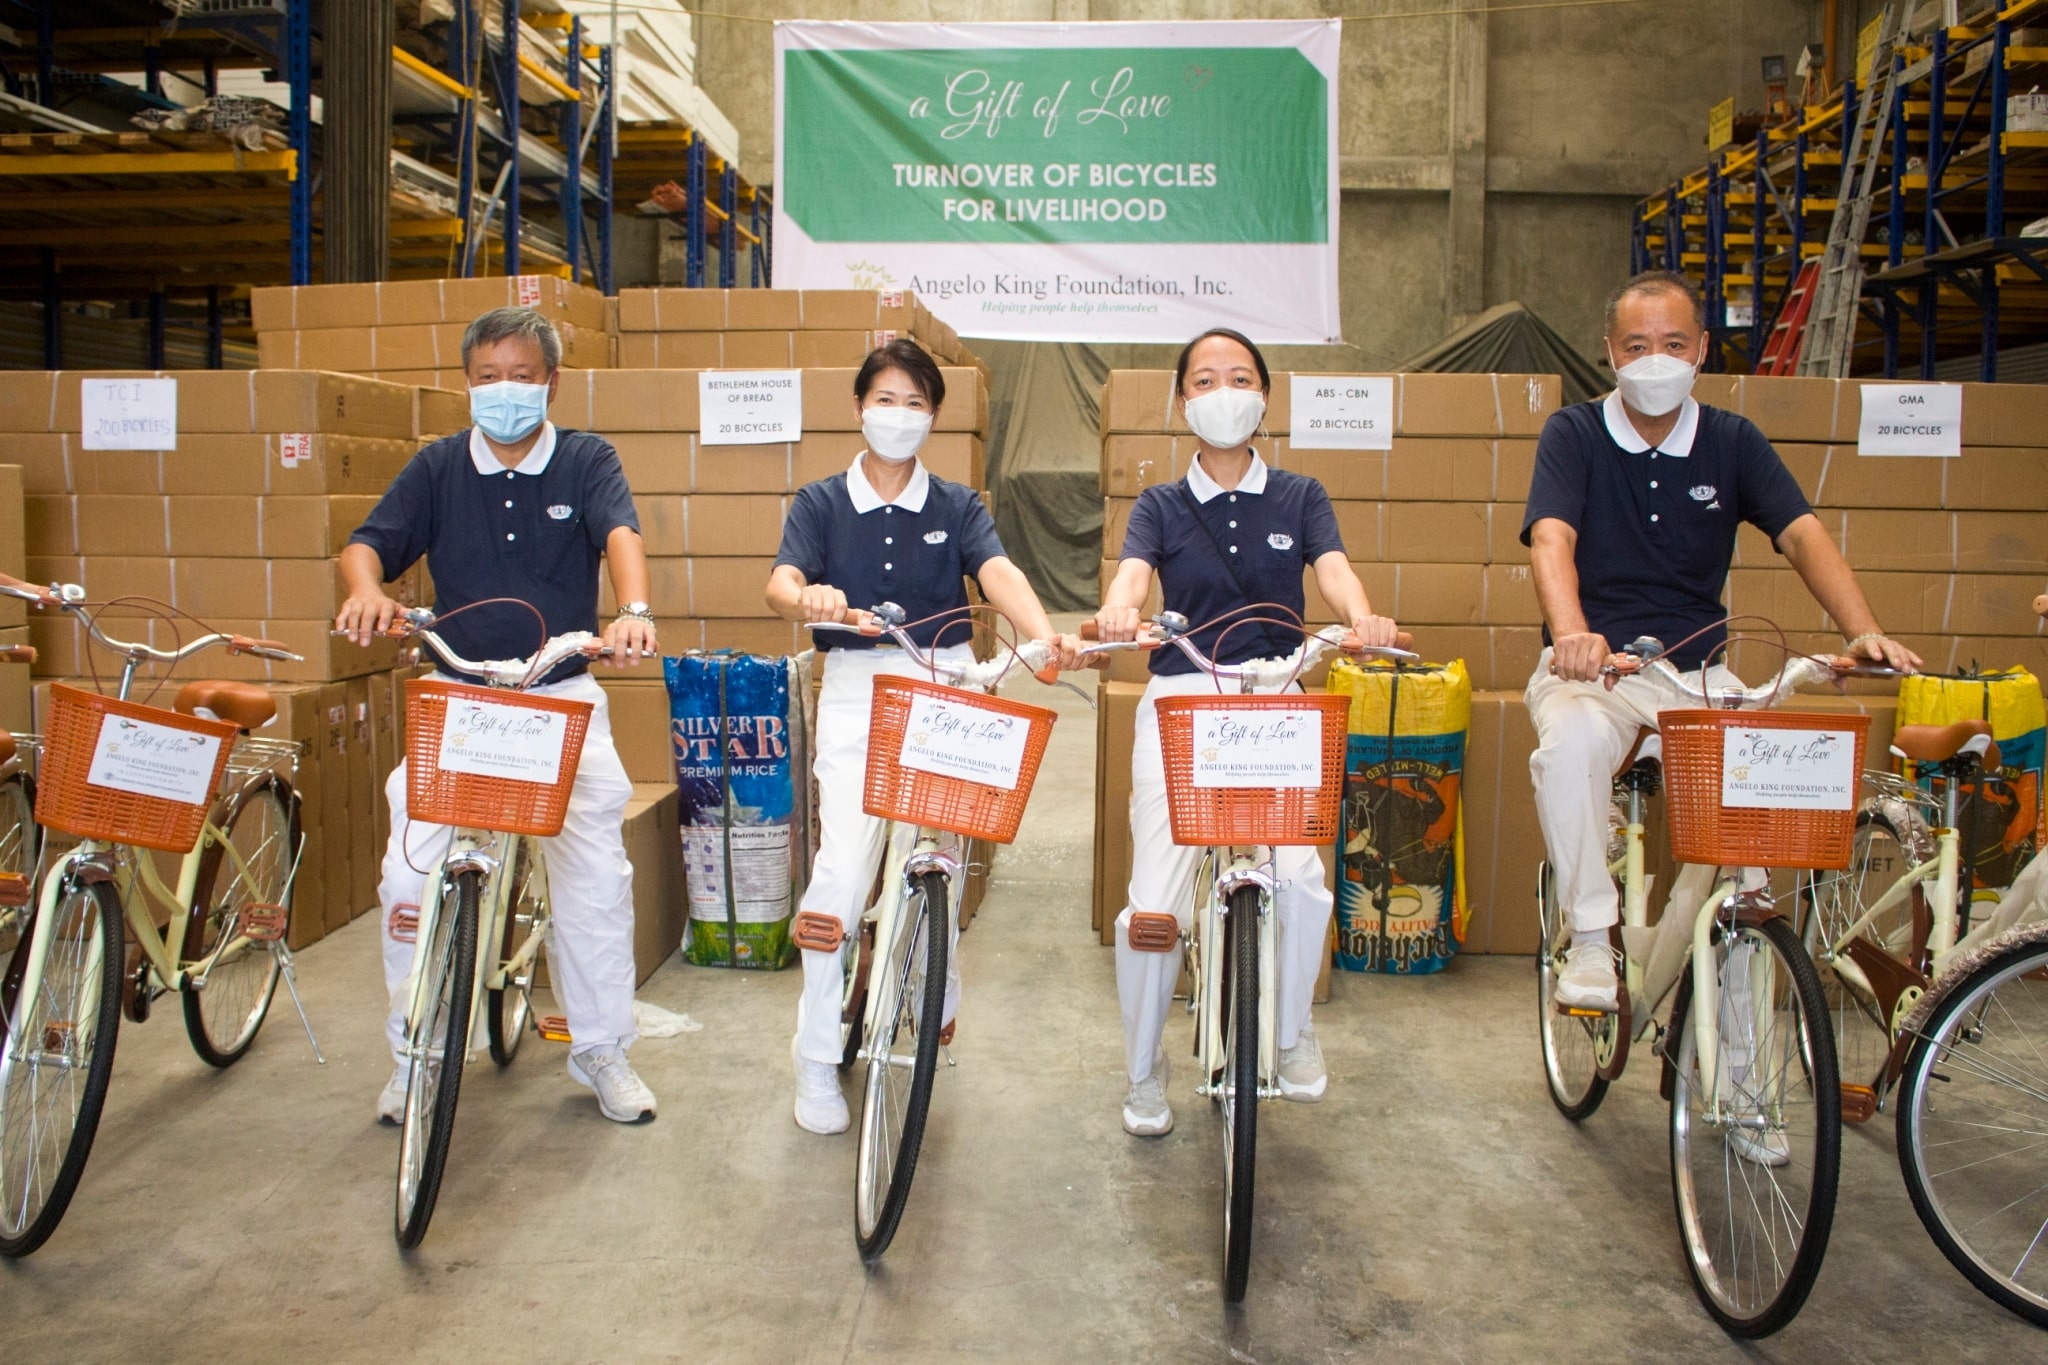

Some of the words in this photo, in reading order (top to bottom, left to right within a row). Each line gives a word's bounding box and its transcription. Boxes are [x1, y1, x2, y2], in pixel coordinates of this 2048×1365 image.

[909, 96, 930, 118] a
[941, 69, 1024, 139] Gift
[1033, 80, 1071, 138] of
[1077, 67, 1171, 134] Love
[893, 164, 1034, 187] TURNOVER
[1044, 164, 1080, 187] OF
[1090, 164, 1216, 187] BICYCLES
[944, 199, 995, 222] FOR
[1006, 199, 1166, 222] LIVELIHOOD
[909, 275, 985, 299] Angelo
[995, 275, 1047, 299] King
[1056, 275, 1184, 297] Foundation,
[1195, 275, 1233, 295] Inc.
[982, 302, 1026, 313] Helping
[1030, 303, 1066, 314] people
[1070, 302, 1093, 313] help
[1097, 302, 1158, 312] themselves
[709, 381, 758, 389] BETHLEHEM
[762, 380, 792, 388] HOUSE
[103, 384, 141, 401] TCI
[744, 394, 773, 402] BREAD
[1316, 389, 1335, 398] ABS
[1346, 389, 1369, 398] CBN
[1899, 395, 1925, 404] GMA
[720, 425, 731, 433] 20
[735, 423, 783, 432] BICYCLES
[1310, 420, 1321, 428] 20
[1325, 420, 1374, 429] BICYCLES
[1878, 426, 1890, 435] 20
[1893, 426, 1941, 435] BICYCLES
[468, 712, 497, 734] Gift
[498, 720, 512, 736] of
[513, 719, 543, 738] Love
[931, 712, 961, 735] Gift
[962, 722, 976, 739] of
[976, 723, 1004, 743] Love
[672, 715, 787, 760] STAR
[1219, 721, 1248, 745] Gift
[1250, 725, 1263, 745] of
[1265, 721, 1298, 743] Love
[447, 748, 472, 756] ANGELO
[475, 751, 492, 759] KING
[909, 746, 935, 756] ANGELO
[937, 752, 952, 760] KING
[1402, 747, 1411, 756] OF
[1416, 743, 1459, 756] PRODUCT
[1750, 740, 1781, 764] Gift
[1782, 745, 1797, 765] of
[1798, 741, 1831, 765] Love
[745, 765, 778, 776] RICE
[732, 831, 765, 839] Nutrition
